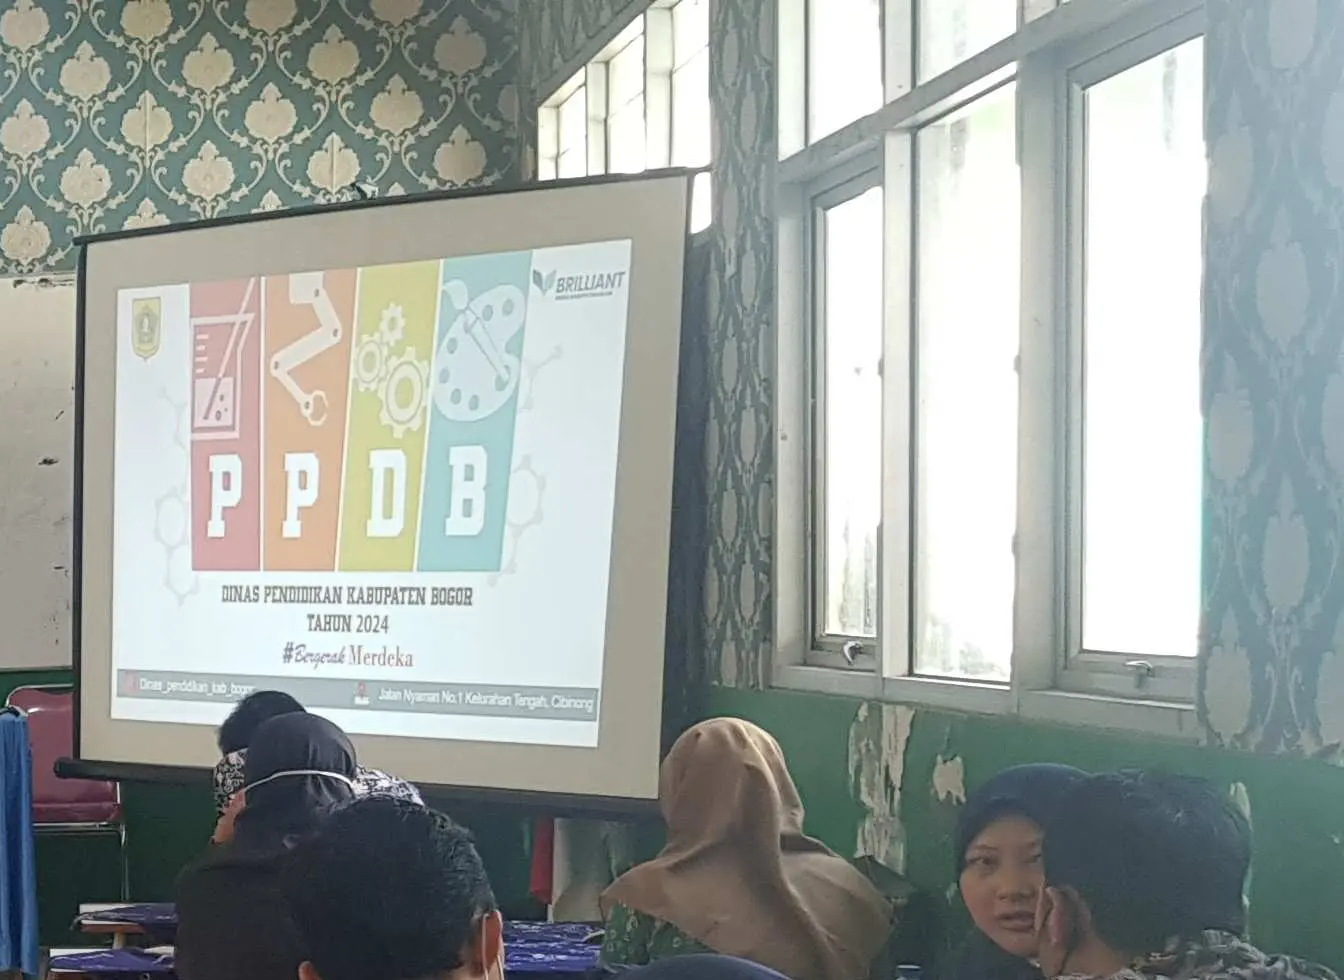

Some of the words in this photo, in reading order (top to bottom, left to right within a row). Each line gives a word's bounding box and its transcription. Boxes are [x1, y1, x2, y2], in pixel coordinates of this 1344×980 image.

[221, 585, 260, 602] DINAS
[264, 585, 342, 604] PENDIDIKAN
[346, 586, 426, 605] KABUPATEN
[430, 587, 473, 606] BOGOR
[306, 614, 351, 632] TAHUN
[356, 614, 389, 633] 2024
[348, 645, 413, 668] Merdeka
